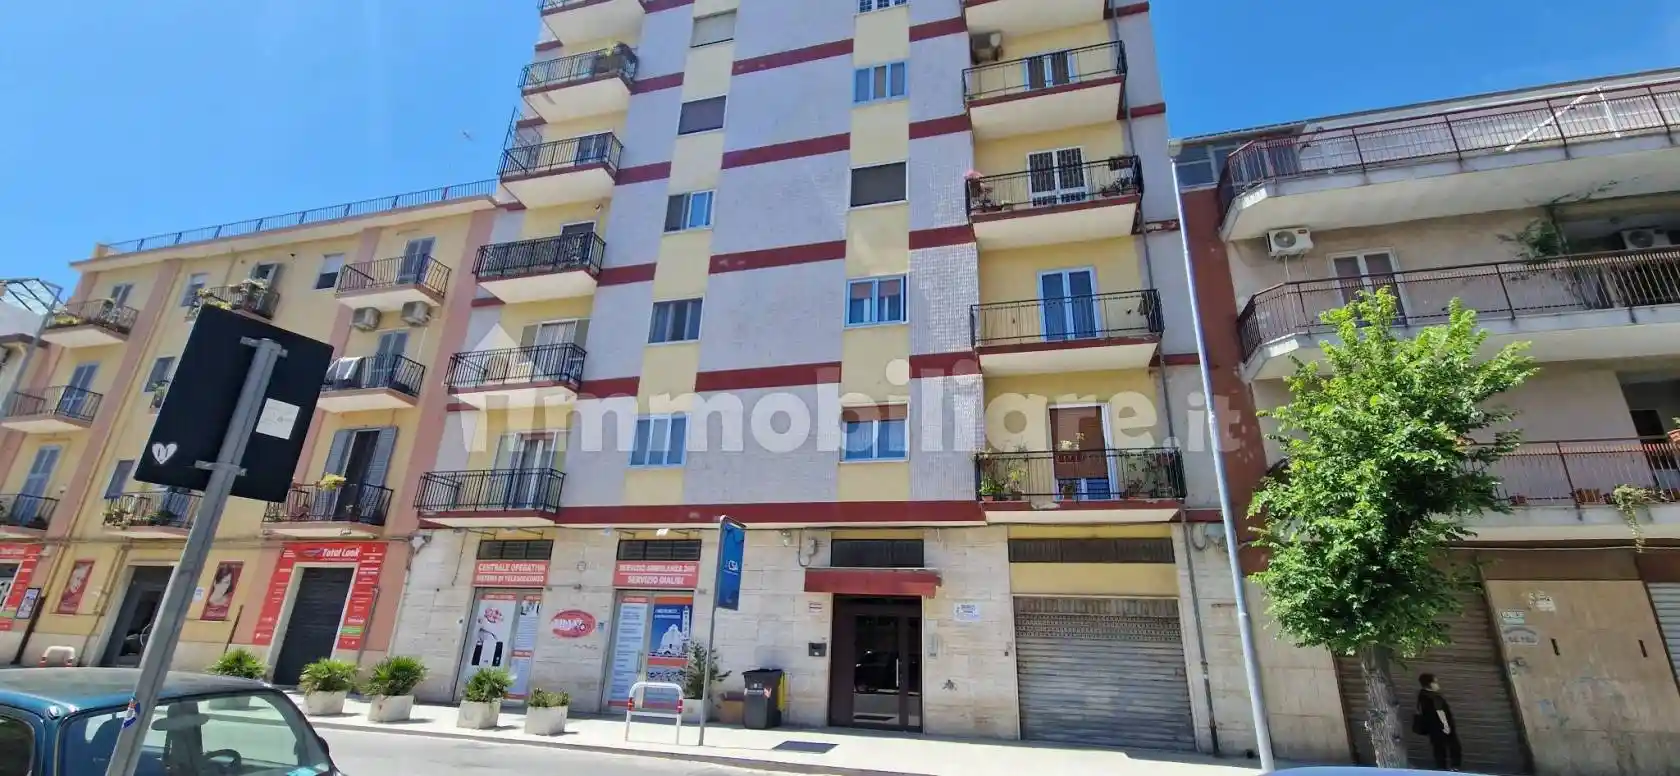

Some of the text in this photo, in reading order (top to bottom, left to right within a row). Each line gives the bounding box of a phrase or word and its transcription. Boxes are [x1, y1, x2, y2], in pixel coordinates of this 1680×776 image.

[322, 547, 360, 557] Total Look
[478, 563, 510, 572] CENTRALE
[627, 575, 659, 585] SERVIZIO
